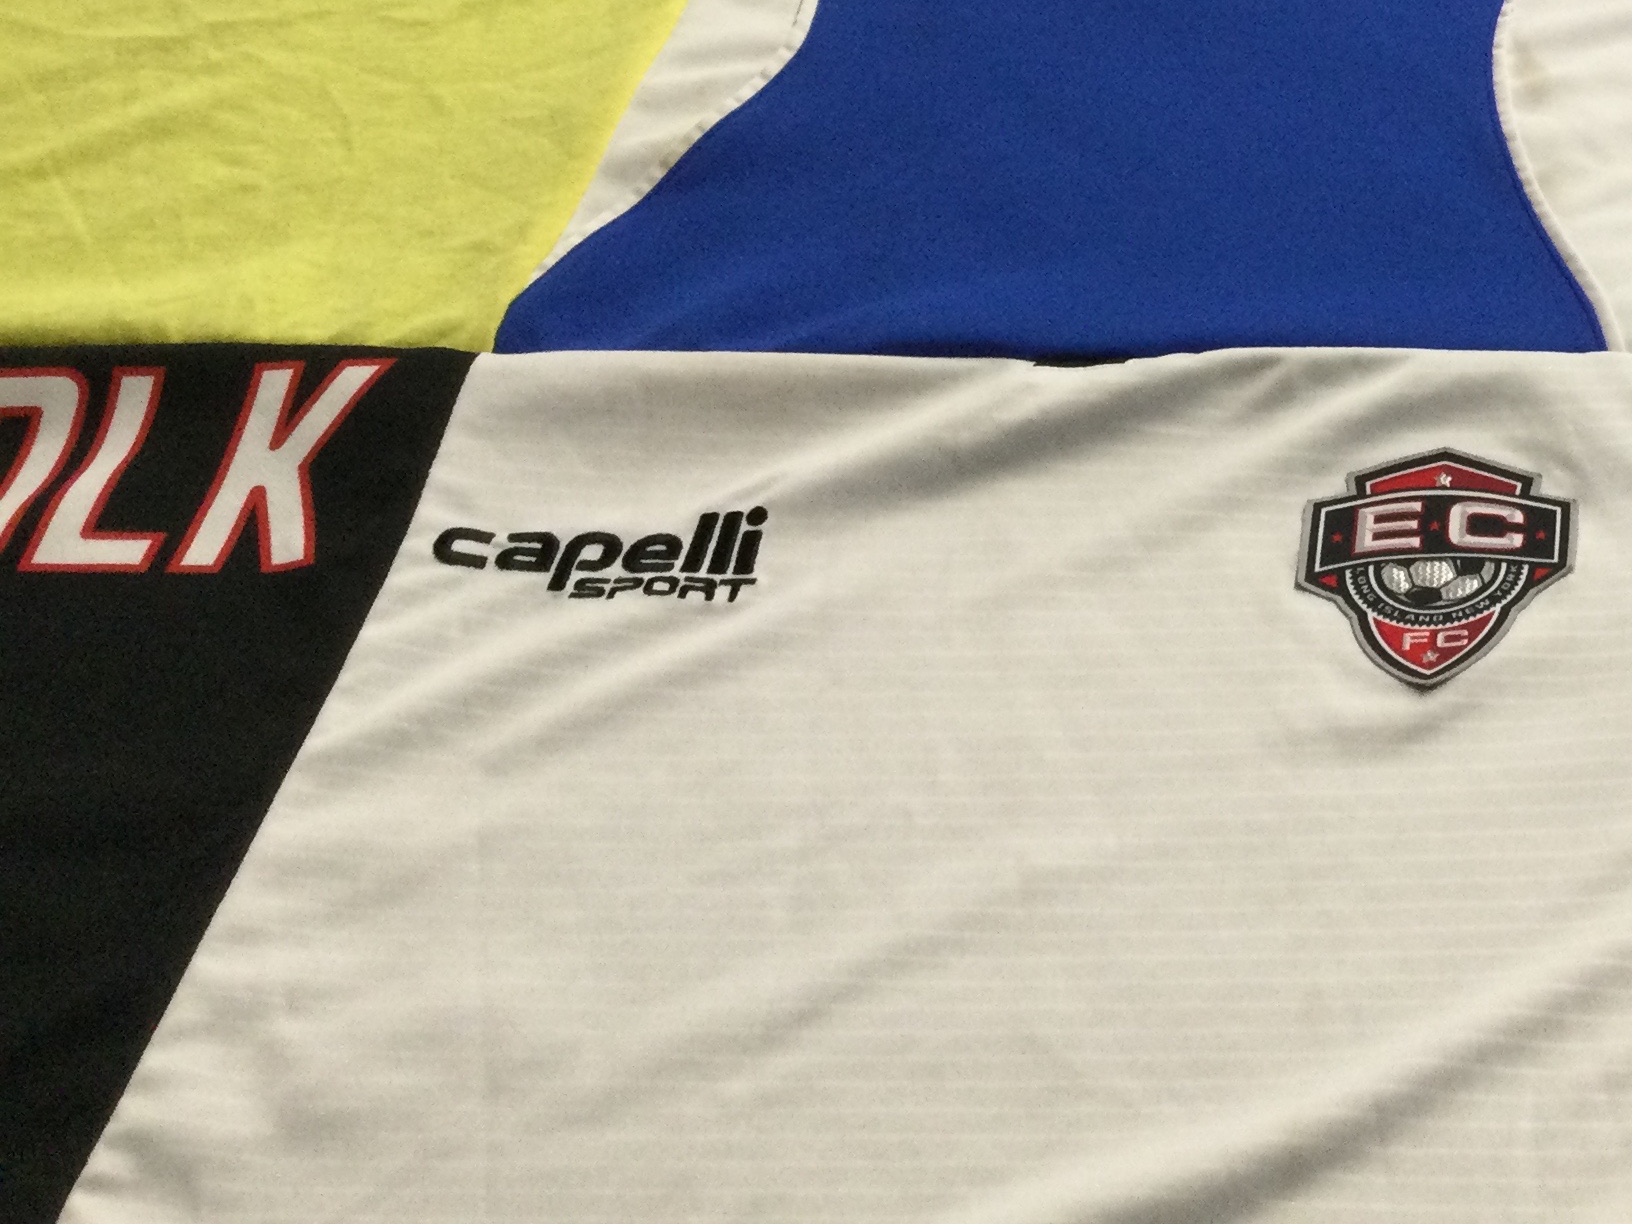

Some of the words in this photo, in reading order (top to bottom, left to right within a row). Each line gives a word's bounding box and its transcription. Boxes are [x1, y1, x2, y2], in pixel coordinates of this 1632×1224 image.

[432, 505, 769, 593] capelli
[568, 574, 759, 604] SPORT
[1353, 566, 1377, 606] LONG
[1378, 597, 1445, 623] ISLAND
[1451, 597, 1492, 619] NEW
[1494, 564, 1519, 599] YORK
[1402, 628, 1469, 651] FC
